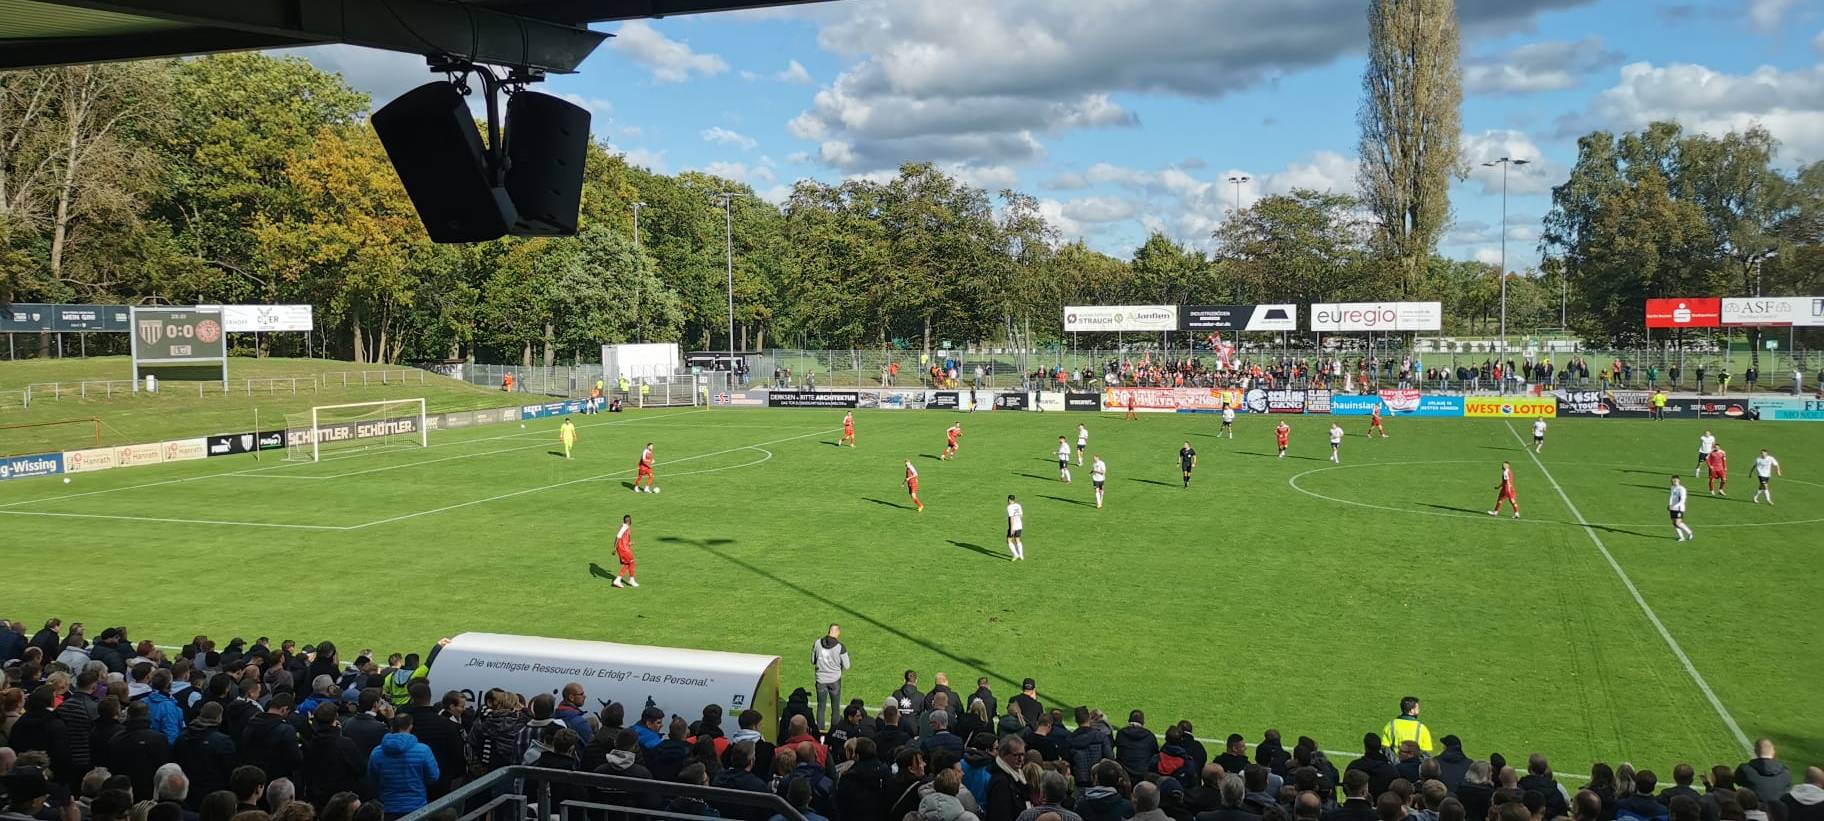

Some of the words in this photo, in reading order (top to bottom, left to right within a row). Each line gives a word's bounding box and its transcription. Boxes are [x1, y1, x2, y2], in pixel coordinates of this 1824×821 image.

[1317, 306, 1397, 327] euregio
[1466, 404, 1501, 414] WEST
[1513, 404, 1555, 414] LOTTO
[0, 458, 57, 477] g-Wissing
[486, 659, 531, 672] wichtigste
[532, 663, 581, 676] Ressource
[583, 667, 596, 677] für
[597, 668, 632, 682] Erfolg?
[642, 672, 661, 683] Das
